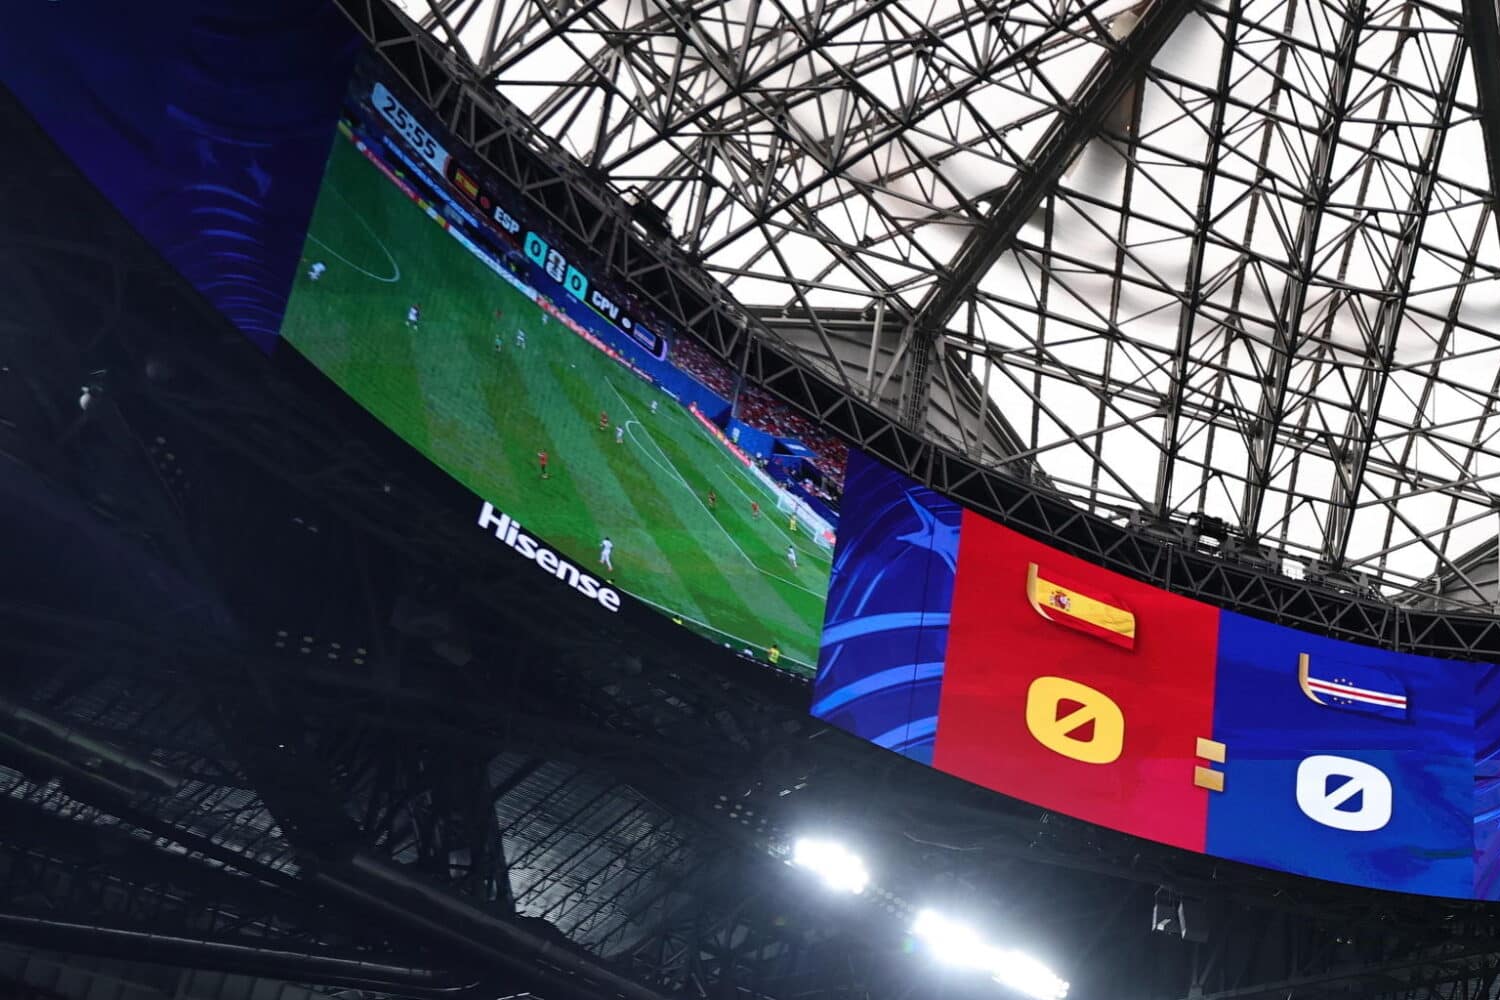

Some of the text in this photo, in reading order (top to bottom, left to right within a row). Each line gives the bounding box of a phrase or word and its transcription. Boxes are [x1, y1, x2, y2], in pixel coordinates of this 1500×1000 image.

[381, 95, 437, 159] 25:55
[494, 206, 520, 234] ESP
[592, 290, 619, 319] CPV
[477, 500, 621, 612] Hisense
